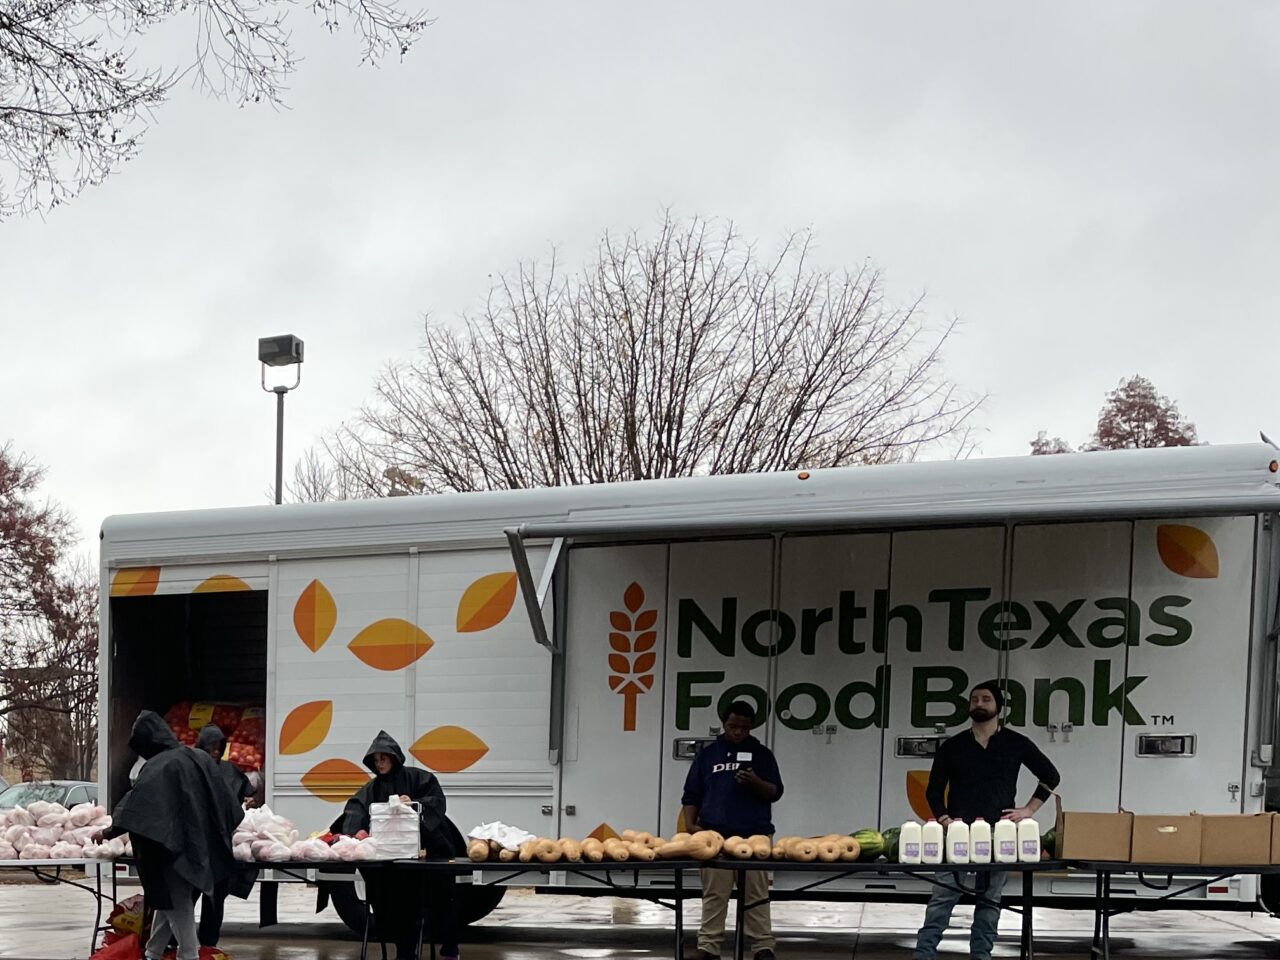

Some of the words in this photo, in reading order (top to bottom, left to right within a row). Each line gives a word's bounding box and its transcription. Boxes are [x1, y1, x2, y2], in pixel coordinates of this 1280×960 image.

[677, 589, 922, 658] North
[928, 587, 1193, 651] Texas
[675, 664, 891, 731] Food
